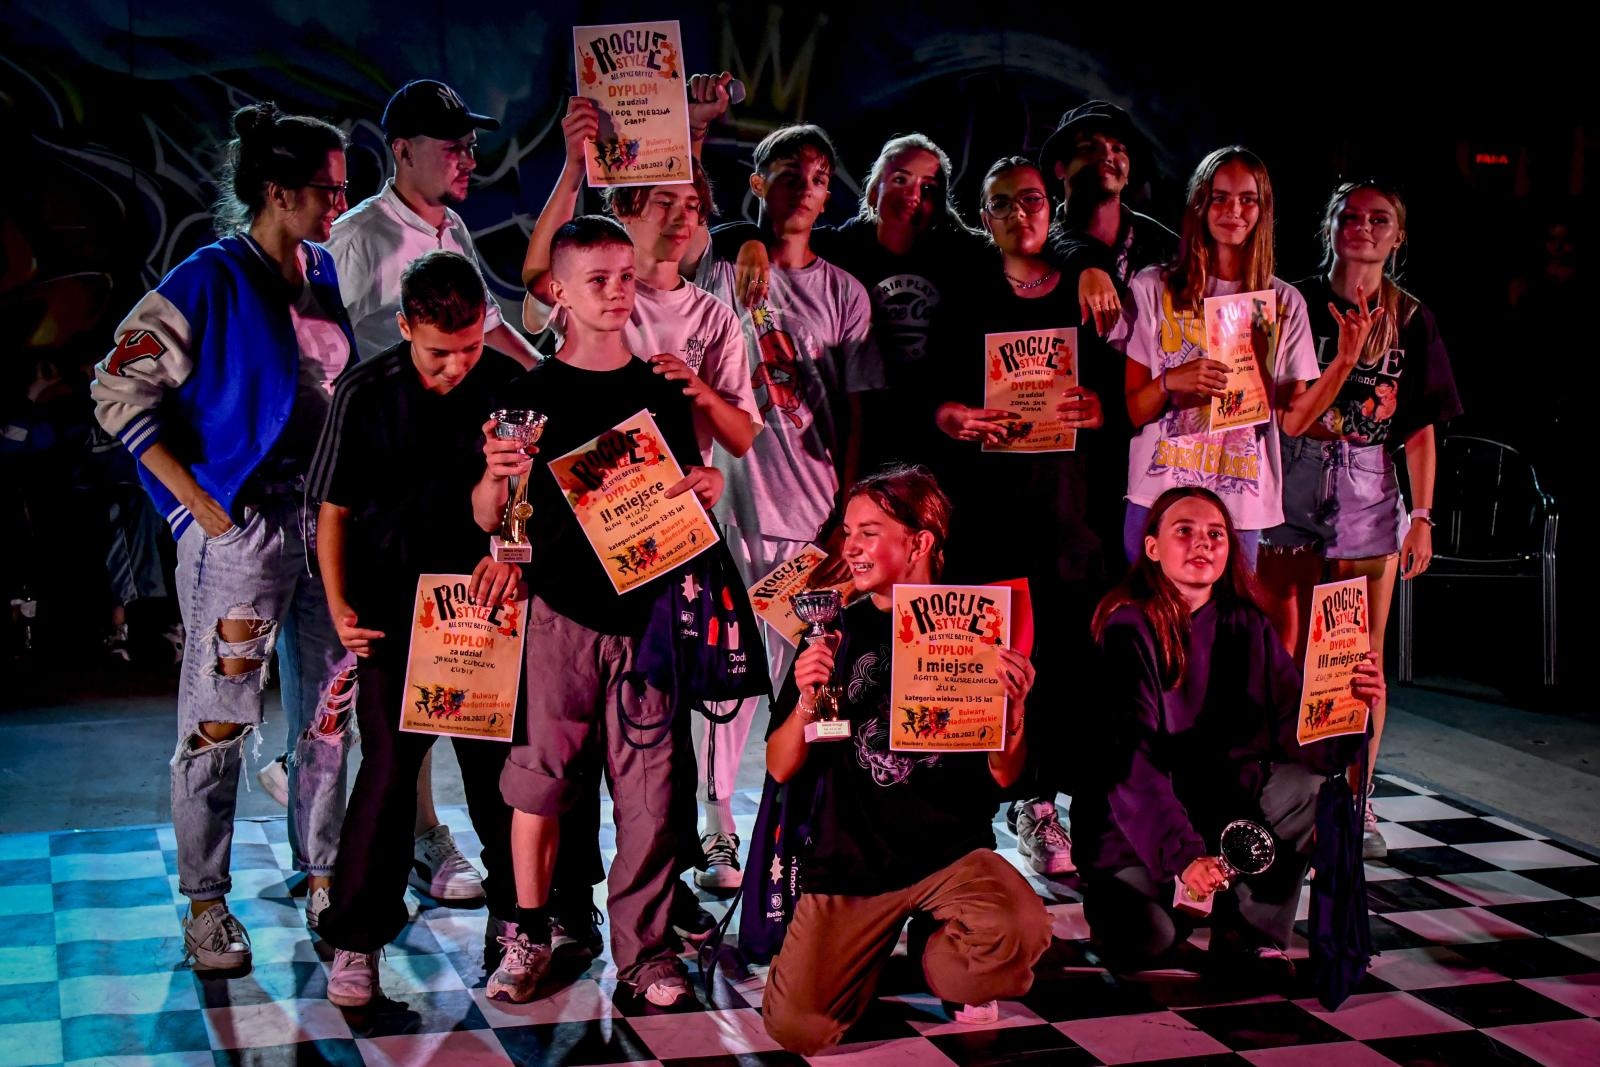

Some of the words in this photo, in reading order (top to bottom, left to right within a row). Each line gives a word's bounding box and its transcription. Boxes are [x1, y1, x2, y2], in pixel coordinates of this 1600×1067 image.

[590, 30, 667, 75] ROGUE
[616, 54, 647, 70] STYLE
[608, 82, 658, 97] DYPLOM
[627, 97, 648, 106] udział
[998, 336, 1065, 373] ROGUE
[1020, 356, 1047, 369] STYLE
[1011, 379, 1054, 391] DYPLOM
[569, 428, 646, 491] ROGUE
[605, 474, 646, 503] DYPLOM
[600, 508, 613, 523] II
[615, 481, 665, 516] miejsce
[608, 533, 636, 551] kategoria
[636, 521, 660, 537] wiekowa
[660, 509, 676, 522] 13-15
[676, 504, 685, 515] lat
[754, 554, 809, 598] ROGUE
[456, 607, 490, 621] STYLE
[910, 591, 995, 636] ROGUE
[1322, 587, 1362, 632] ROGUE
[935, 617, 970, 631] STYLE
[1335, 611, 1354, 626] STYLE
[443, 633, 494, 649] DYPLOM
[1329, 637, 1357, 651] DYPLOM
[460, 650, 482, 658] udział
[928, 644, 973, 656] DYPLOM
[917, 658, 923, 672] I
[926, 658, 984, 677] miejsce
[1318, 654, 1329, 669] III
[1330, 651, 1364, 667] miejsce
[472, 692, 499, 700] Bulwary
[905, 694, 936, 702] kategoria
[965, 695, 982, 703] 13-15
[959, 708, 985, 716] Bulwary
[943, 730, 975, 739] 26.08.2023
